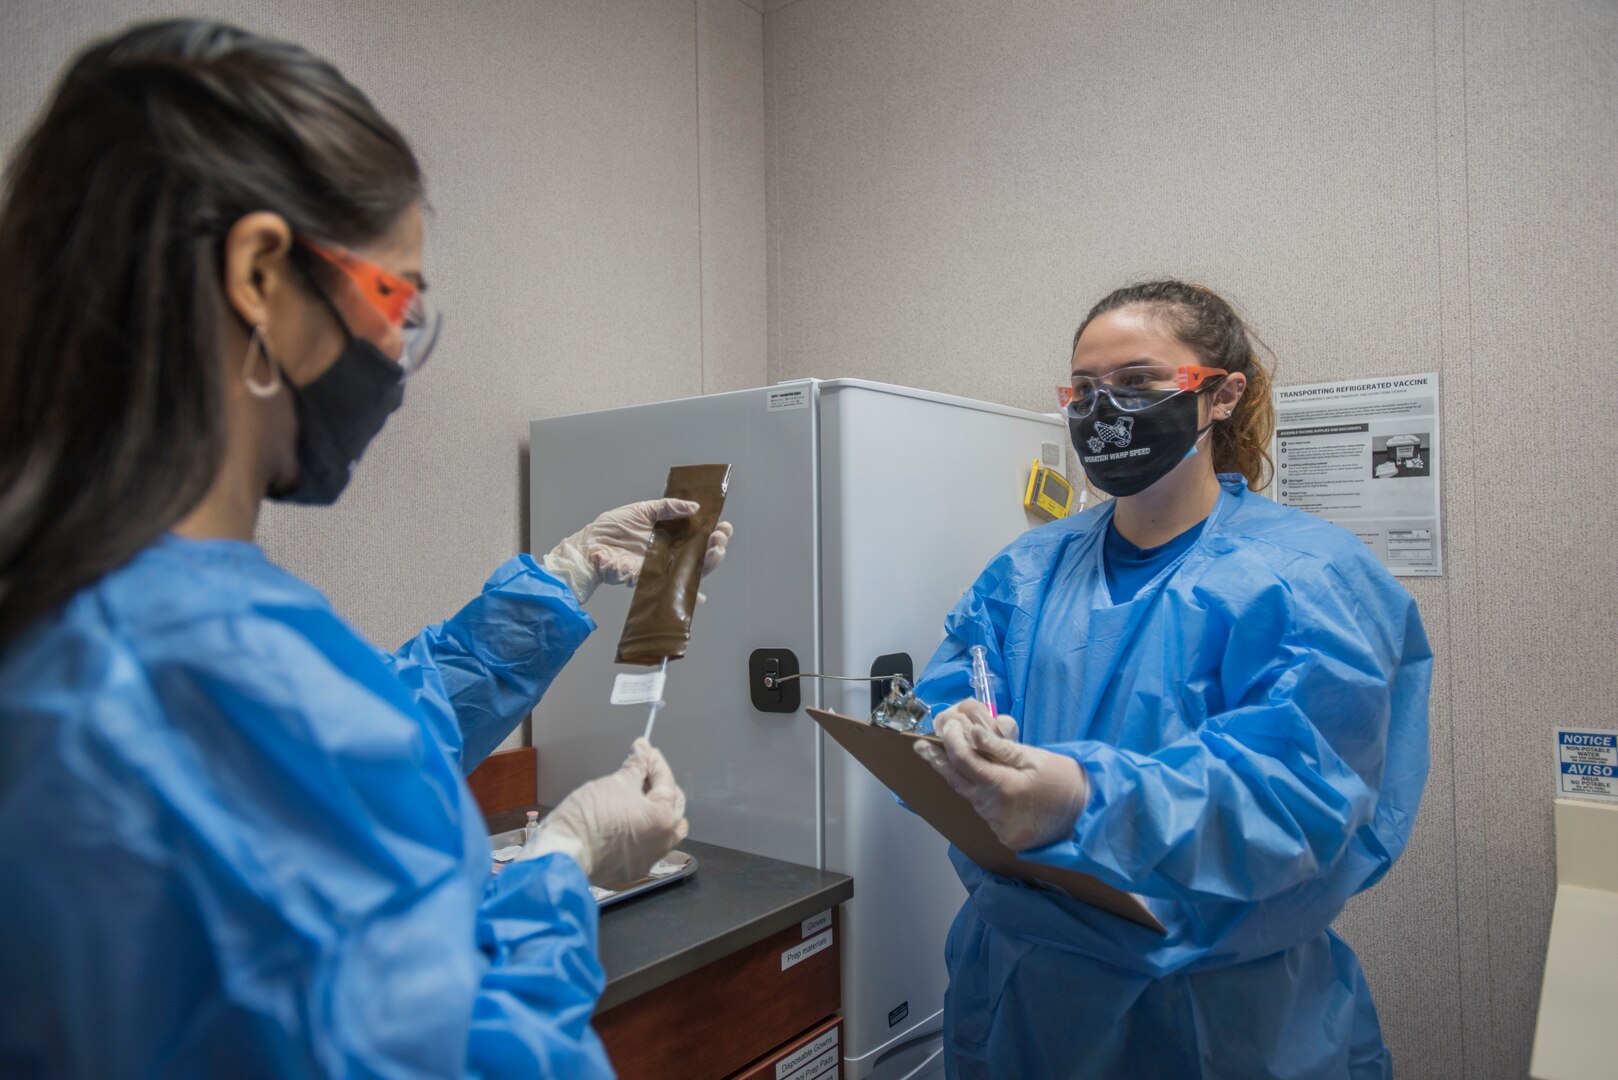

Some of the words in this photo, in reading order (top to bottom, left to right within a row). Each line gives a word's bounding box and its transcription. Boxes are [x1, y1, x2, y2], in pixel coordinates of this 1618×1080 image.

[1280, 387, 1335, 398] TRANSPORTING
[1336, 382, 1392, 393] REFRIGERATED
[1393, 378, 1428, 388] VACCINE
[1109, 452, 1129, 460] WARP
[1129, 447, 1151, 457] SPEED
[1564, 734, 1612, 746] NOTICE
[1568, 764, 1613, 776] AVISO
[807, 917, 826, 931] Gloves
[787, 951, 801, 963] Prep
[802, 937, 827, 954] materials
[781, 1049, 813, 1073] Disposable
[813, 1036, 833, 1052] Gowns
[805, 1065, 819, 1078] Prep
[820, 1056, 834, 1069] Pads
